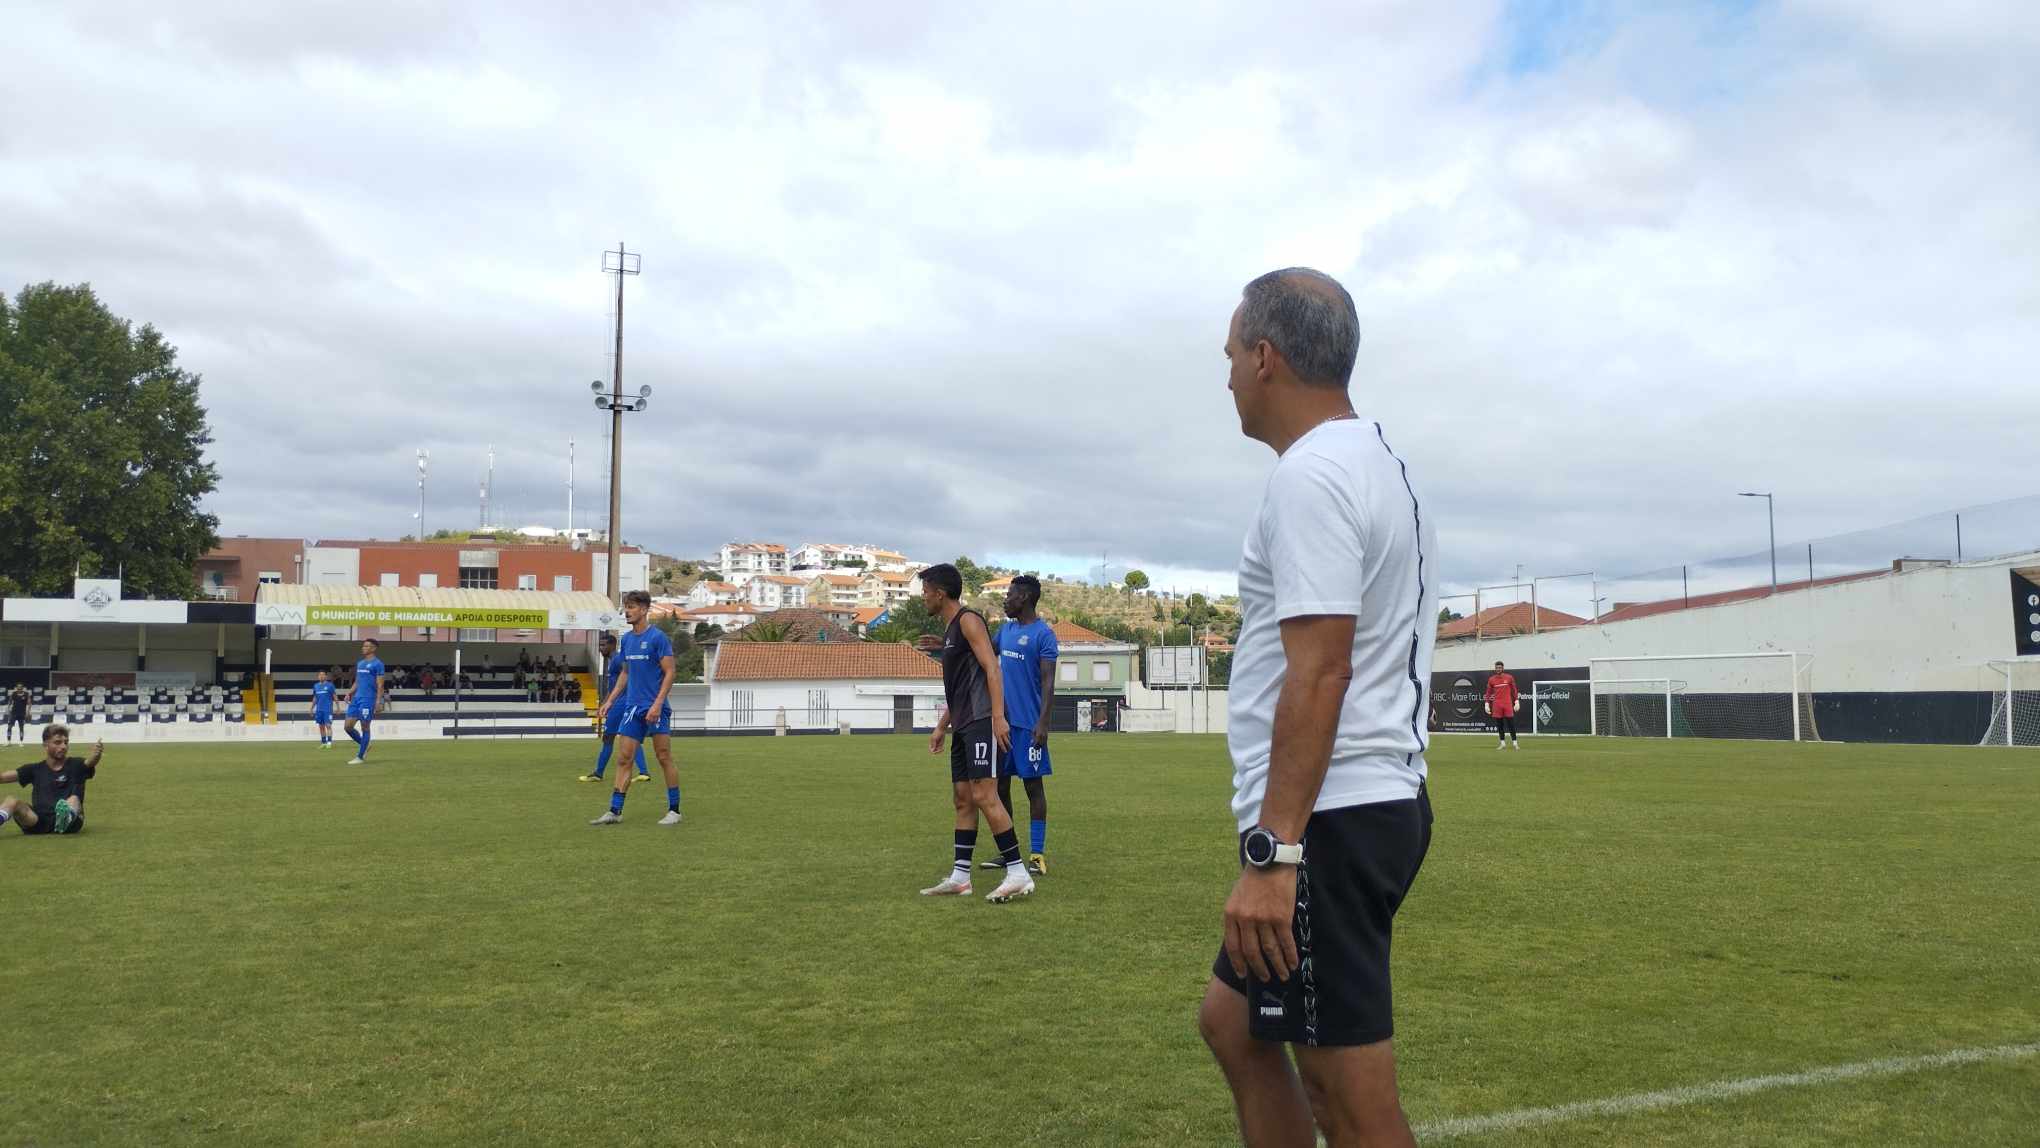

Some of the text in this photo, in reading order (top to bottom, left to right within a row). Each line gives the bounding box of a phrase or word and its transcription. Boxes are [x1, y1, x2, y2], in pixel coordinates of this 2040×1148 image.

[312, 608, 544, 623] O MUNICÍPIO DE MIRANDELA APOIA O DESPORTO
[1552, 691, 1569, 700] Oficial
[975, 742, 988, 759] 17
[1260, 1006, 1283, 1016] PUMA
